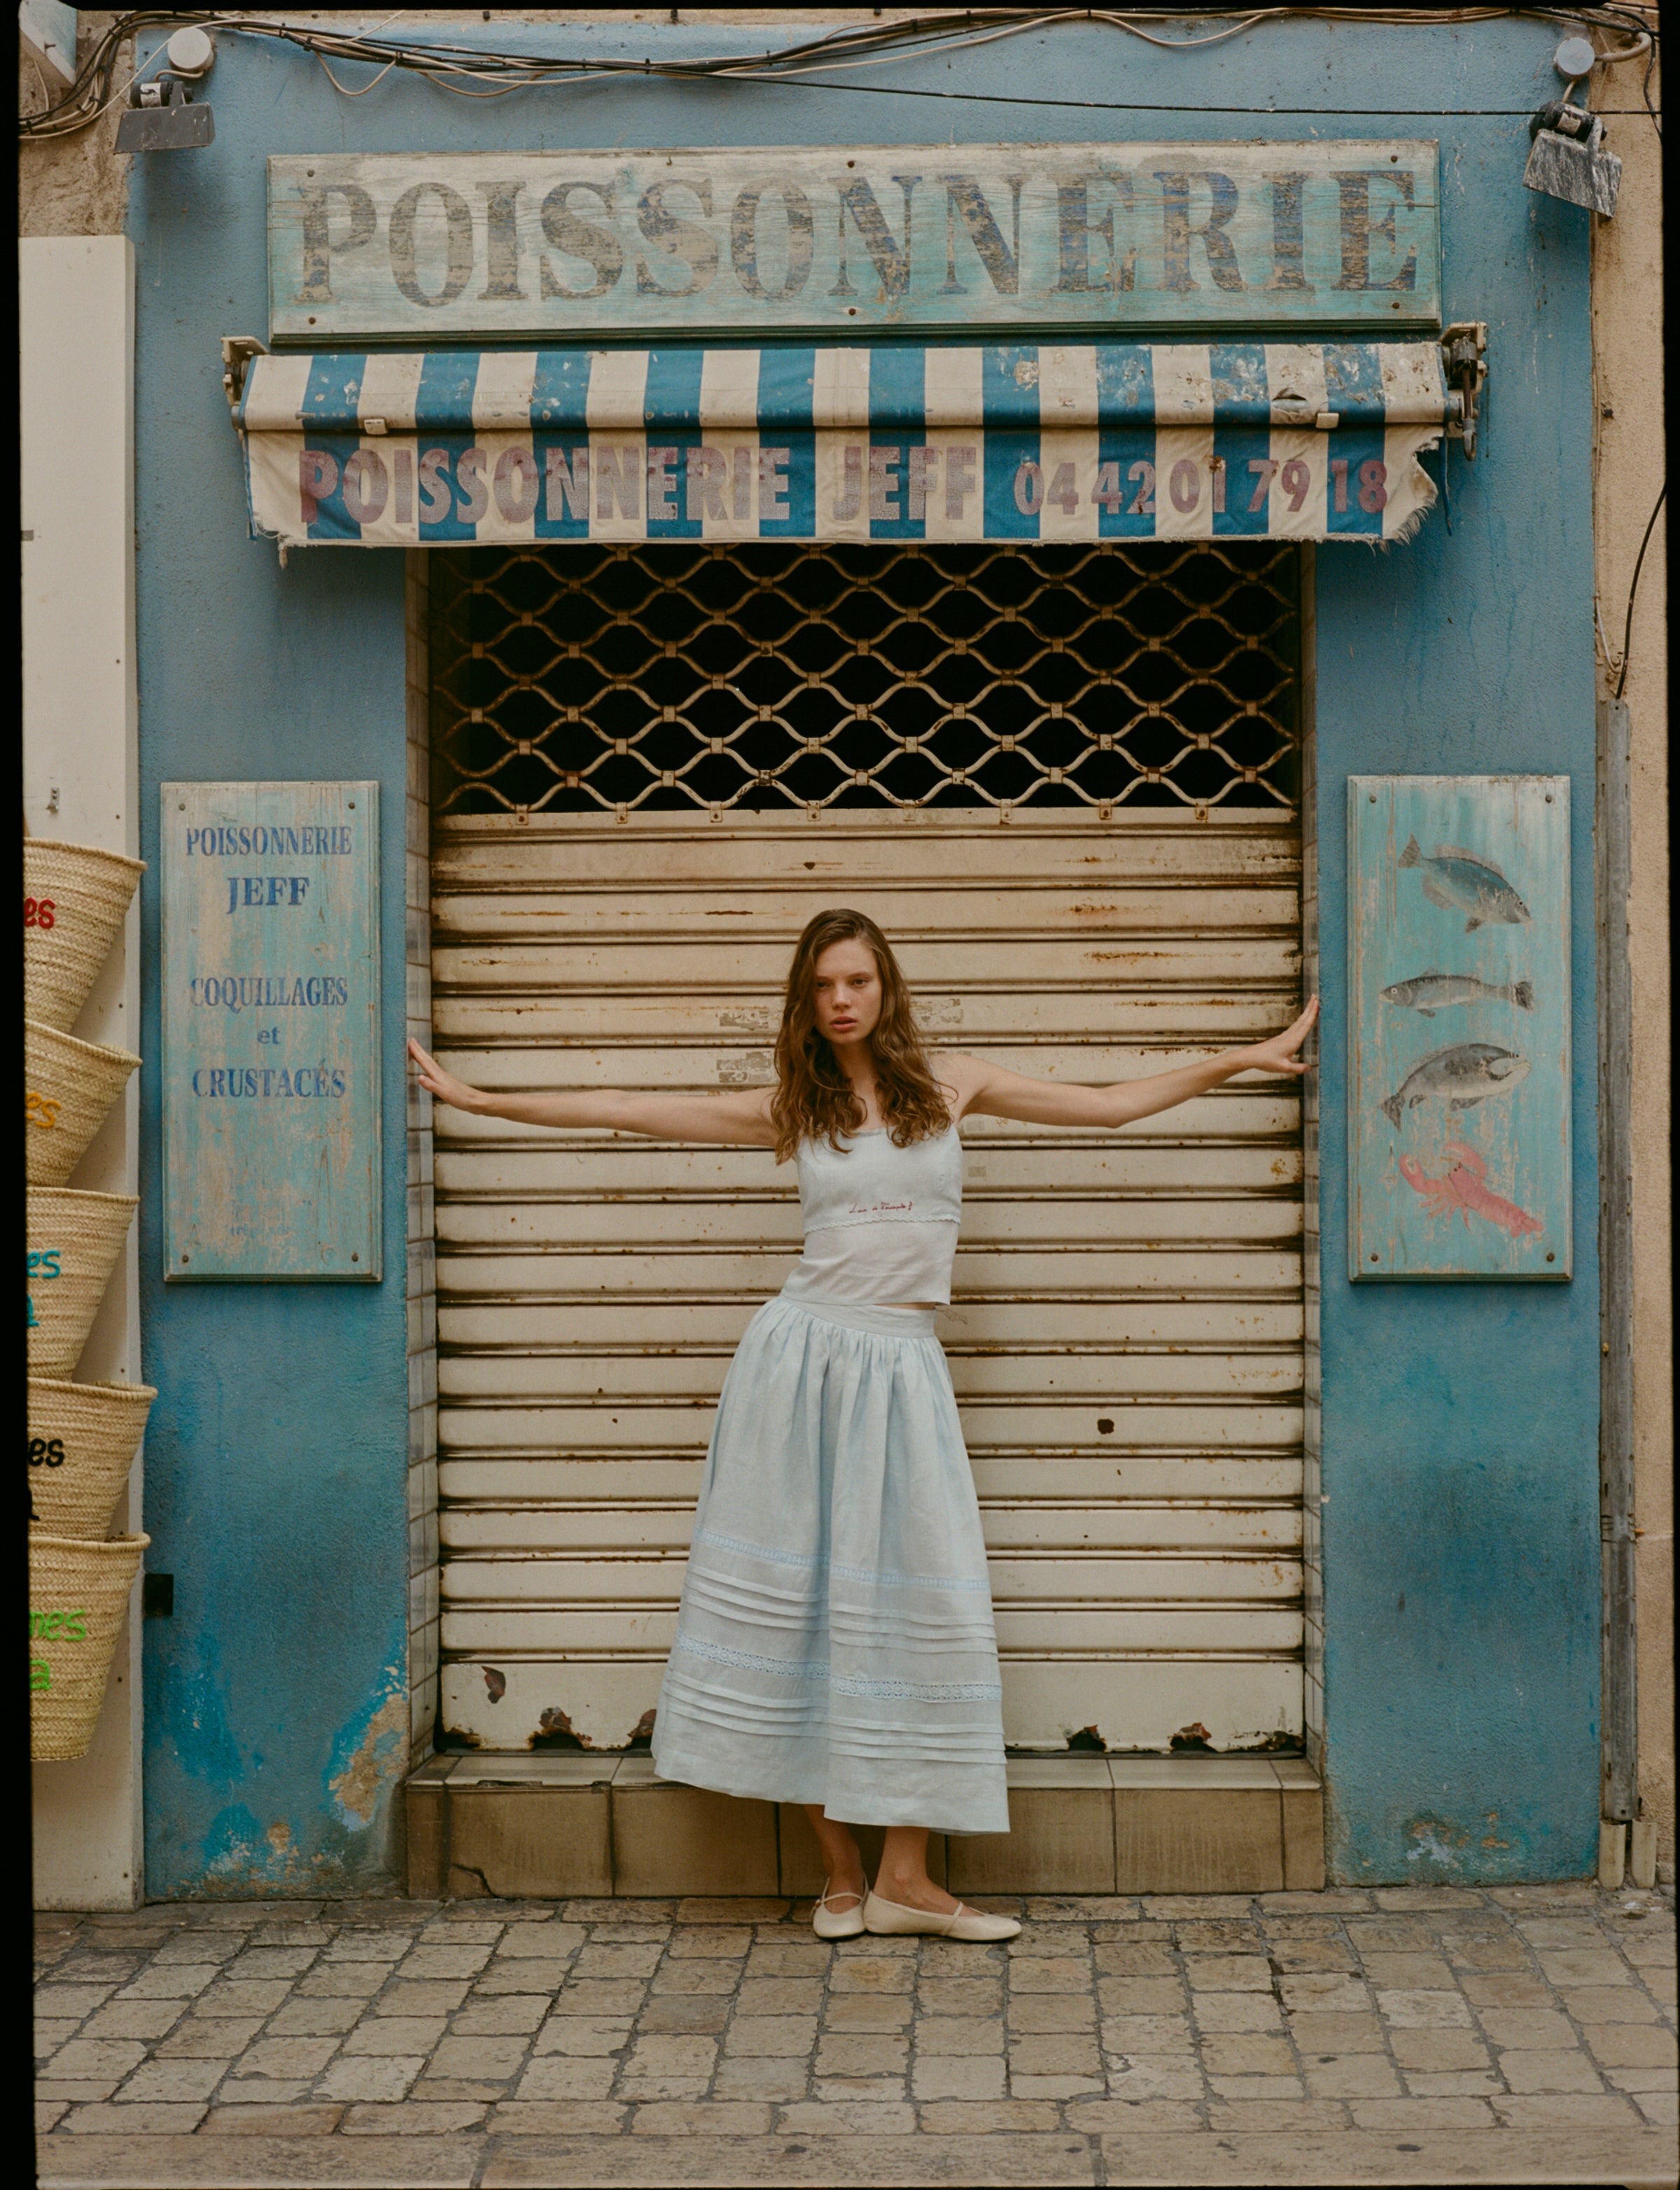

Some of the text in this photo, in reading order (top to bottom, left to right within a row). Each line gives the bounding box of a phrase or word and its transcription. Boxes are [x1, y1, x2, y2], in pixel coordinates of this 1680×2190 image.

[293, 170, 1417, 308] POISSONNERIE
[299, 445, 791, 524] POISSONNERIE
[833, 445, 977, 522] JEFF
[186, 825, 352, 856] POISSONNERIE
[226, 877, 310, 914] JEFF
[190, 976, 348, 1014] COQUILLAGES
[256, 1025, 281, 1045] et
